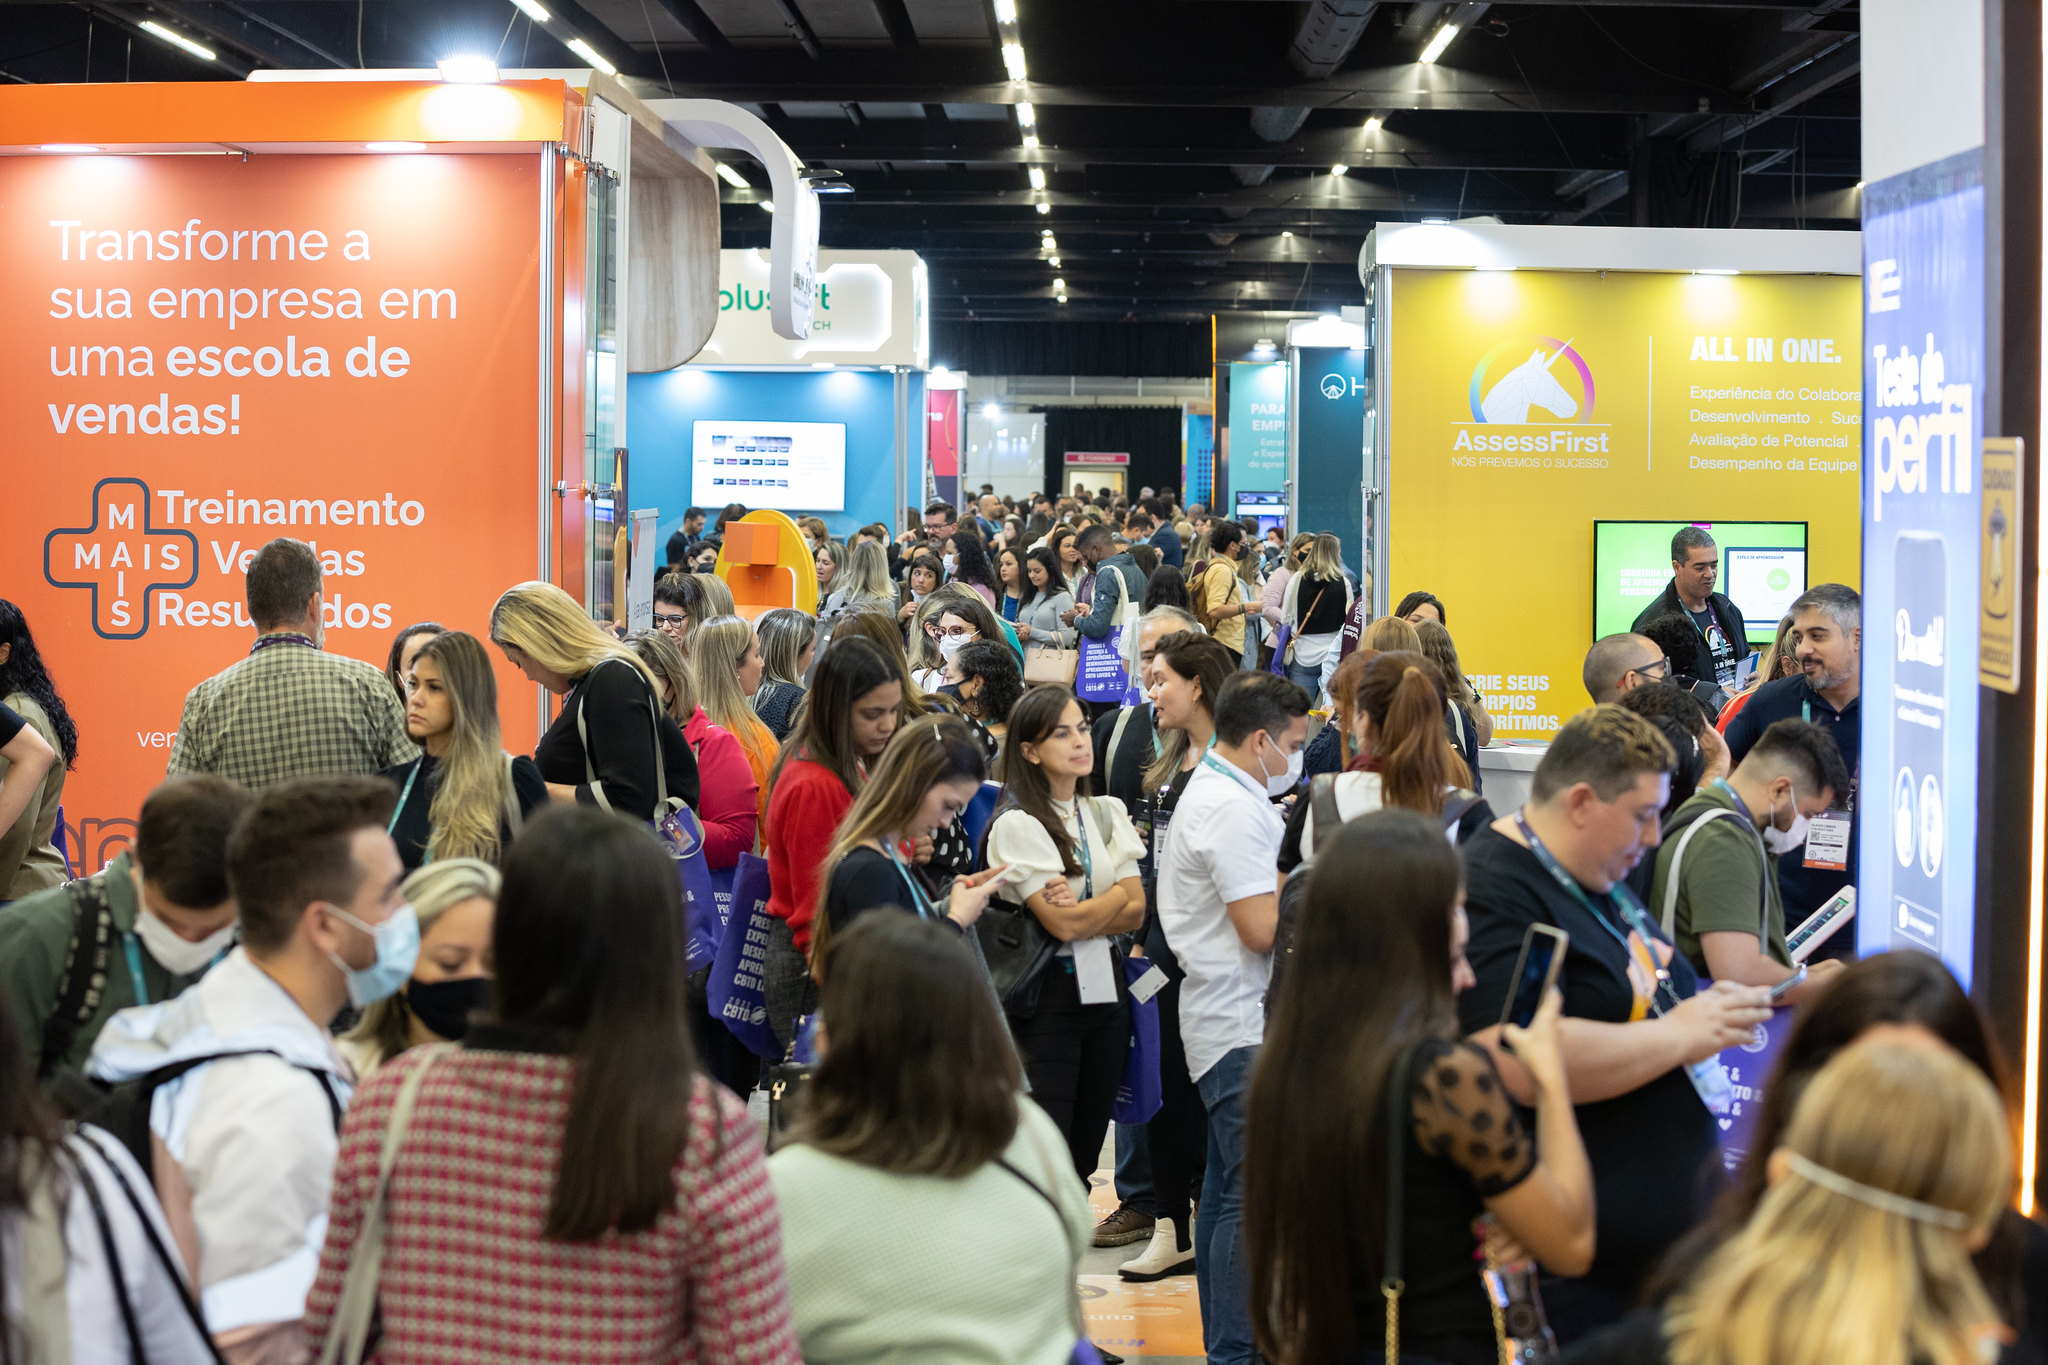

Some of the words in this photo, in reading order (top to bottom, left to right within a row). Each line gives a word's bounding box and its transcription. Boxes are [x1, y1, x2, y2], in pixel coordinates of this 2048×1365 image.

[50, 219, 328, 262] Transforme
[343, 229, 371, 261] a
[49, 287, 132, 320] sua
[148, 287, 363, 330] empresa
[379, 287, 457, 320] em
[50, 343, 154, 377] uma
[166, 336, 331, 378] escola
[345, 336, 411, 378] de
[1689, 336, 1739, 362] ALL
[1747, 337, 1773, 362] IN
[1782, 338, 1842, 364] ONE.
[1873, 344, 1919, 408] Teste
[1920, 332, 1945, 405] de
[1690, 385, 1772, 402] Experiência
[1776, 387, 1794, 400] do
[48, 394, 241, 435] vendas!
[1251, 403, 1285, 415] PARA
[1690, 409, 1810, 424] Desenvolvimento
[1453, 429, 1609, 453] AssessFirst
[1689, 433, 1757, 450] Avaliação
[1761, 434, 1779, 447] de
[1784, 434, 1848, 448] Potencial
[1873, 383, 1973, 522] perfil
[1452, 455, 1476, 467] NÓS
[1479, 457, 1540, 468] PREVEMOS
[1543, 457, 1553, 468] O
[1555, 457, 1609, 469] SUCESSO
[1689, 456, 1782, 472] Desempenho
[1787, 458, 1804, 471] da
[1809, 458, 1857, 474] Equipe
[157, 489, 425, 526] Treinamento
[1507, 675, 1550, 691] SEUS
[723, 1003, 750, 1022] CBTD
